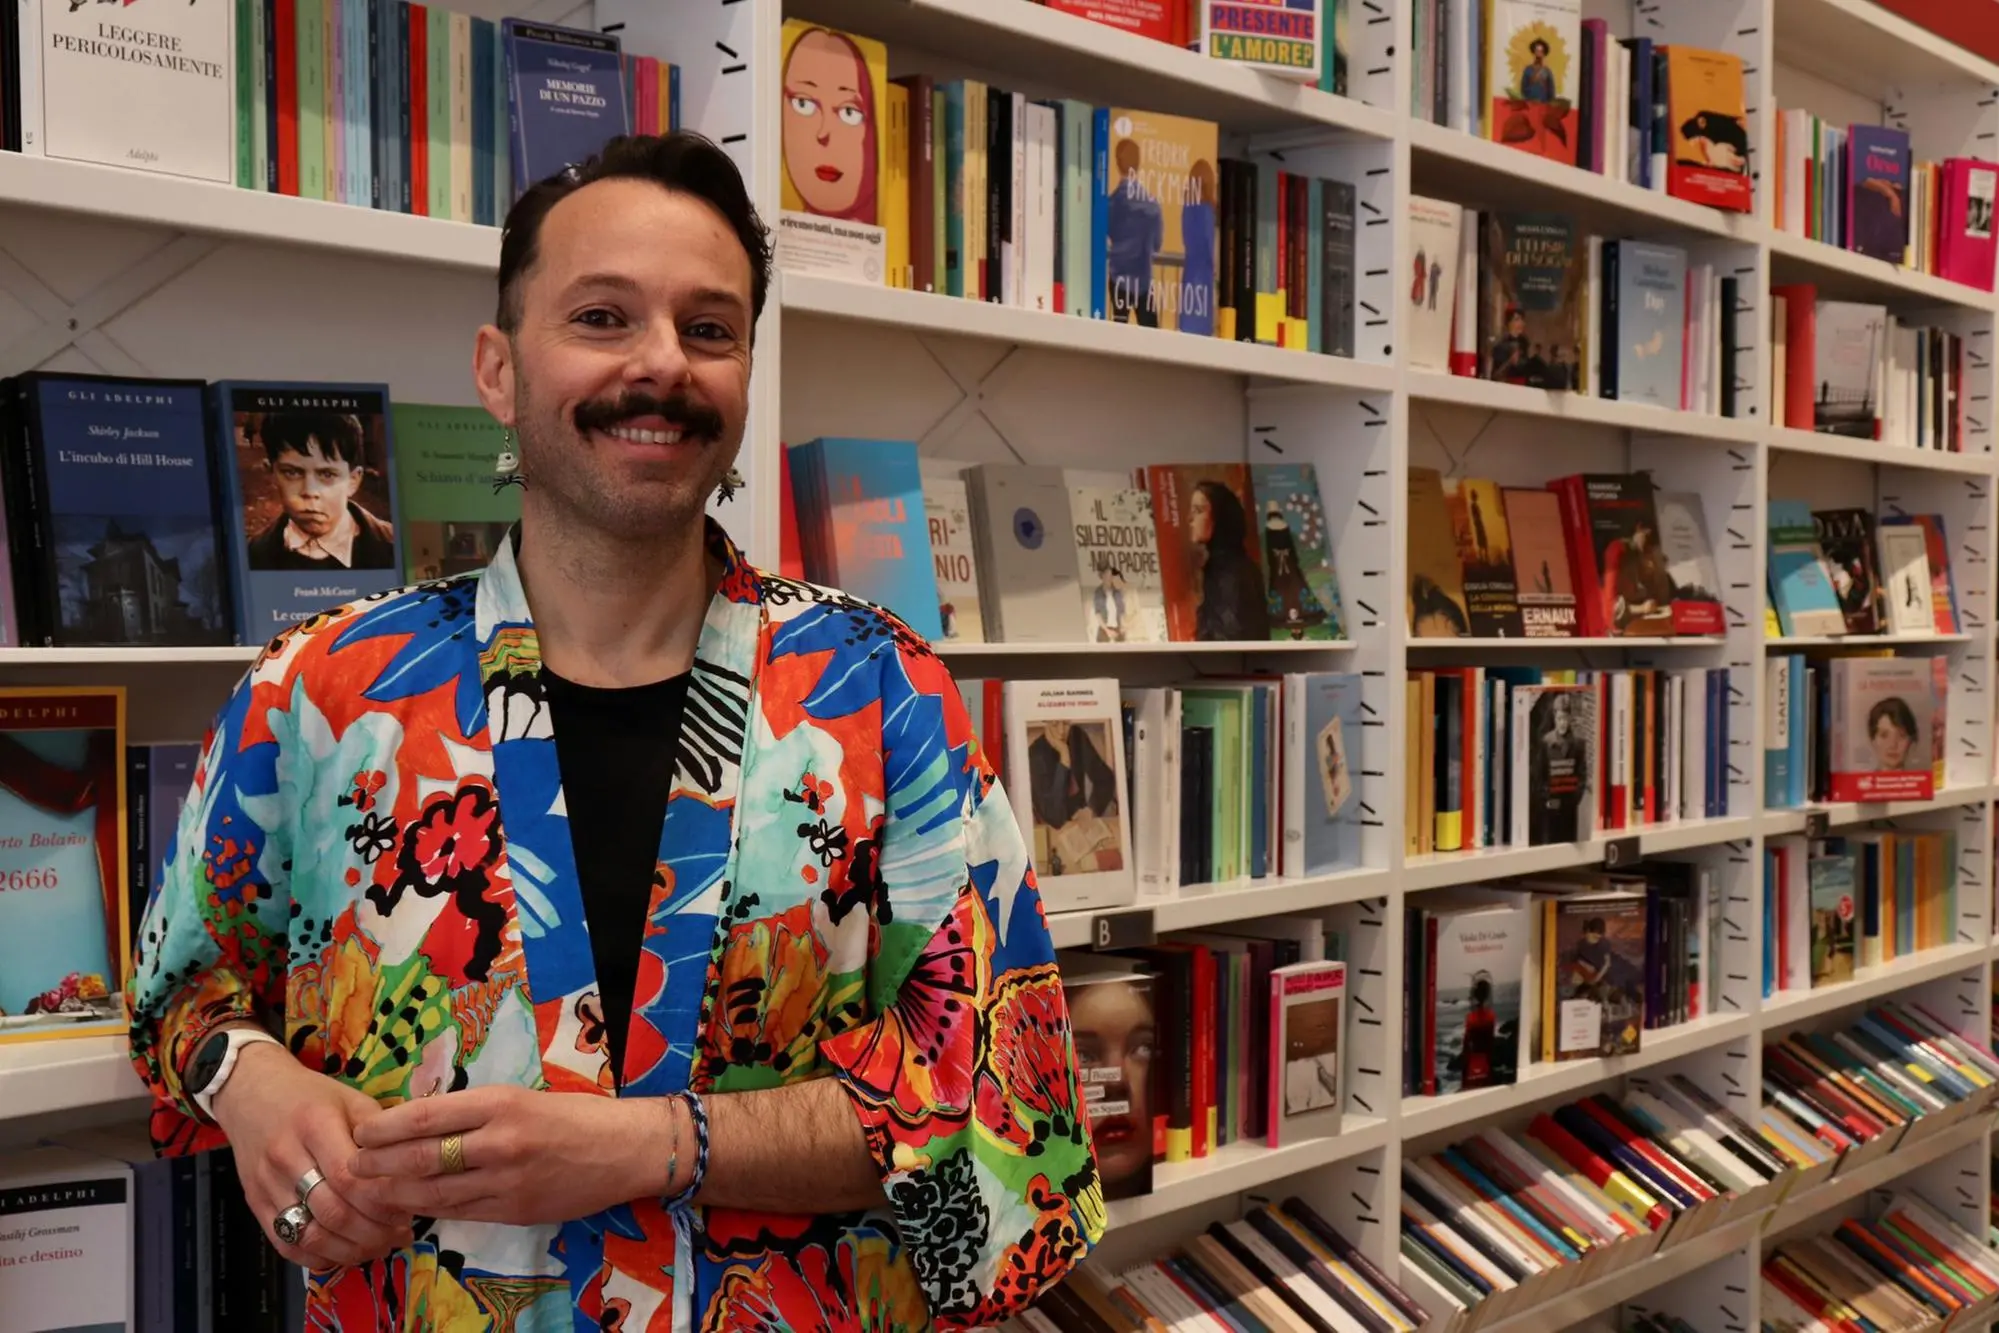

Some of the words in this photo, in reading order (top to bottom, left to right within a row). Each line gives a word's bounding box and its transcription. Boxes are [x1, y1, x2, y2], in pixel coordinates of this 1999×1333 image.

[1212, 6, 1314, 39] PRESENTE
[98, 22, 183, 52] LEGGERE
[51, 33, 223, 79] PERICOLOSAMENTE
[1211, 33, 1312, 66] L'AMORE?
[546, 78, 597, 95] MEMORIE
[1127, 166, 1203, 207] BACKMAN
[1114, 275, 1139, 310] GLI
[1146, 279, 1208, 318] ANSIOSI
[68, 391, 95, 401] GLI
[104, 393, 172, 405] ADELPHI
[257, 397, 284, 407] GLI
[292, 398, 359, 408] ADELPHI
[58, 449, 114, 464] L'incubo
[115, 453, 128, 465] di
[130, 453, 154, 466] Hill
[155, 454, 194, 467] House
[1094, 499, 1109, 522] IL
[1076, 525, 1134, 548] SILENZIO
[1117, 551, 1159, 574] PADRE
[272, 609, 288, 621] Le
[1522, 607, 1577, 625] ERNAUX
[29, 832, 87, 848] Bolaño
[1099, 919, 1111, 947] B
[17, 1188, 97, 1206] ADELPHI
[30, 1248, 84, 1263] destino
